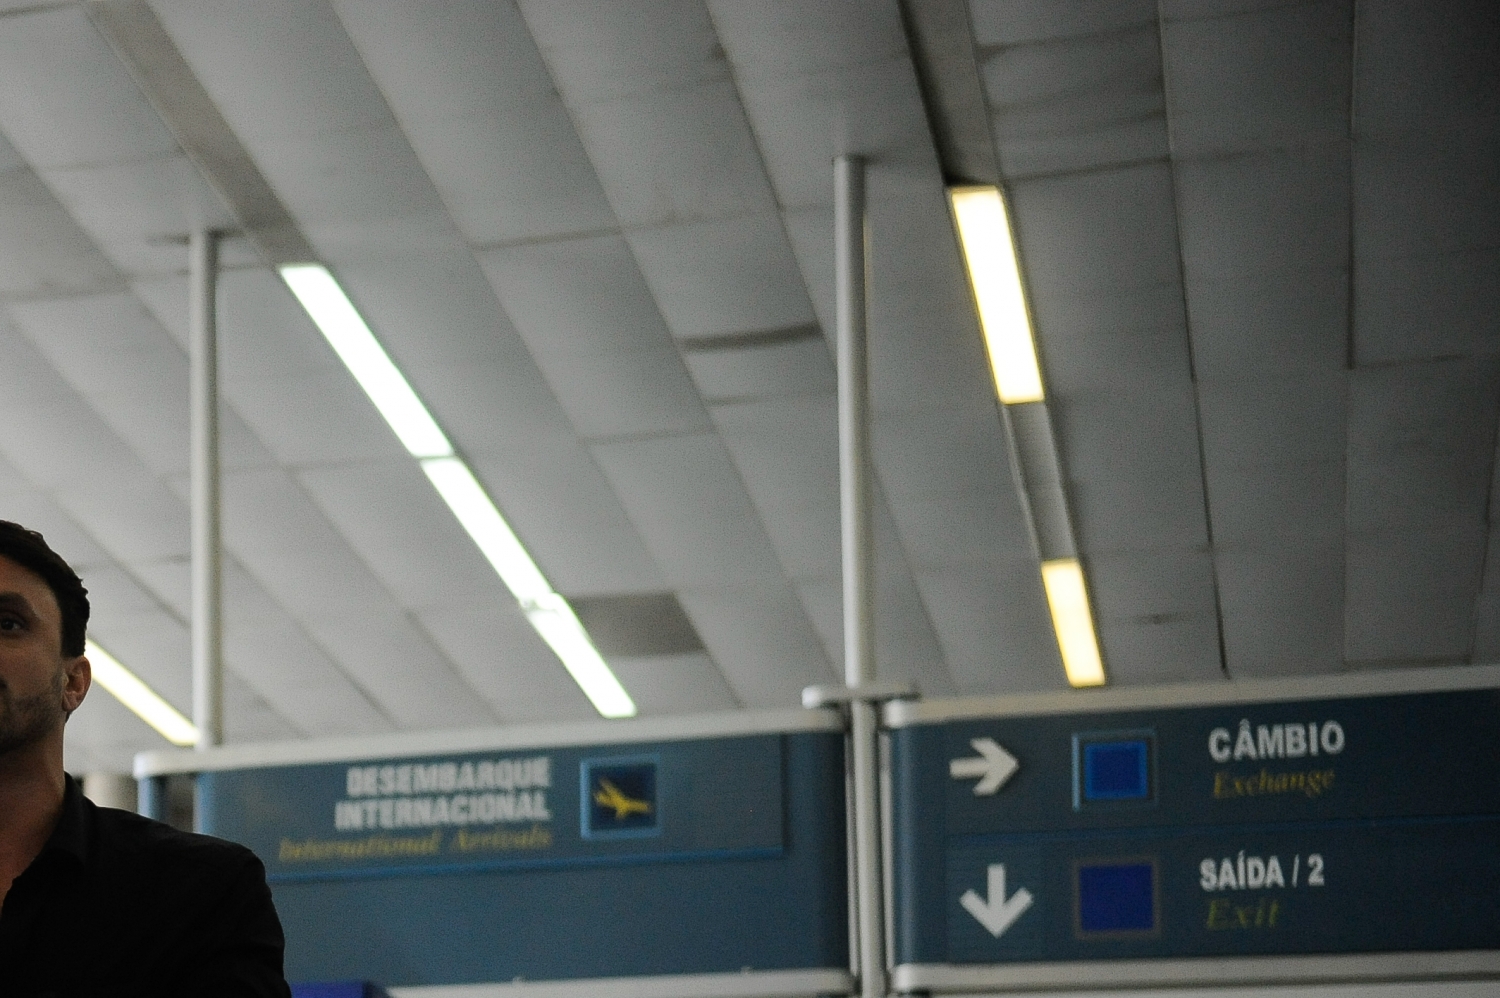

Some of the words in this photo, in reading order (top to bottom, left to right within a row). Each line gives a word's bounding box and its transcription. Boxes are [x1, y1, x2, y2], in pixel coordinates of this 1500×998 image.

[1208, 718, 1345, 763] CÂMBIO
[346, 757, 550, 796] DESEMBARQUE
[1213, 768, 1336, 798] Exchange
[334, 791, 550, 832] INTERNACIONAL
[1200, 850, 1285, 891] SAÍDA
[1307, 853, 1325, 887] 2
[1206, 898, 1280, 931] Exit
